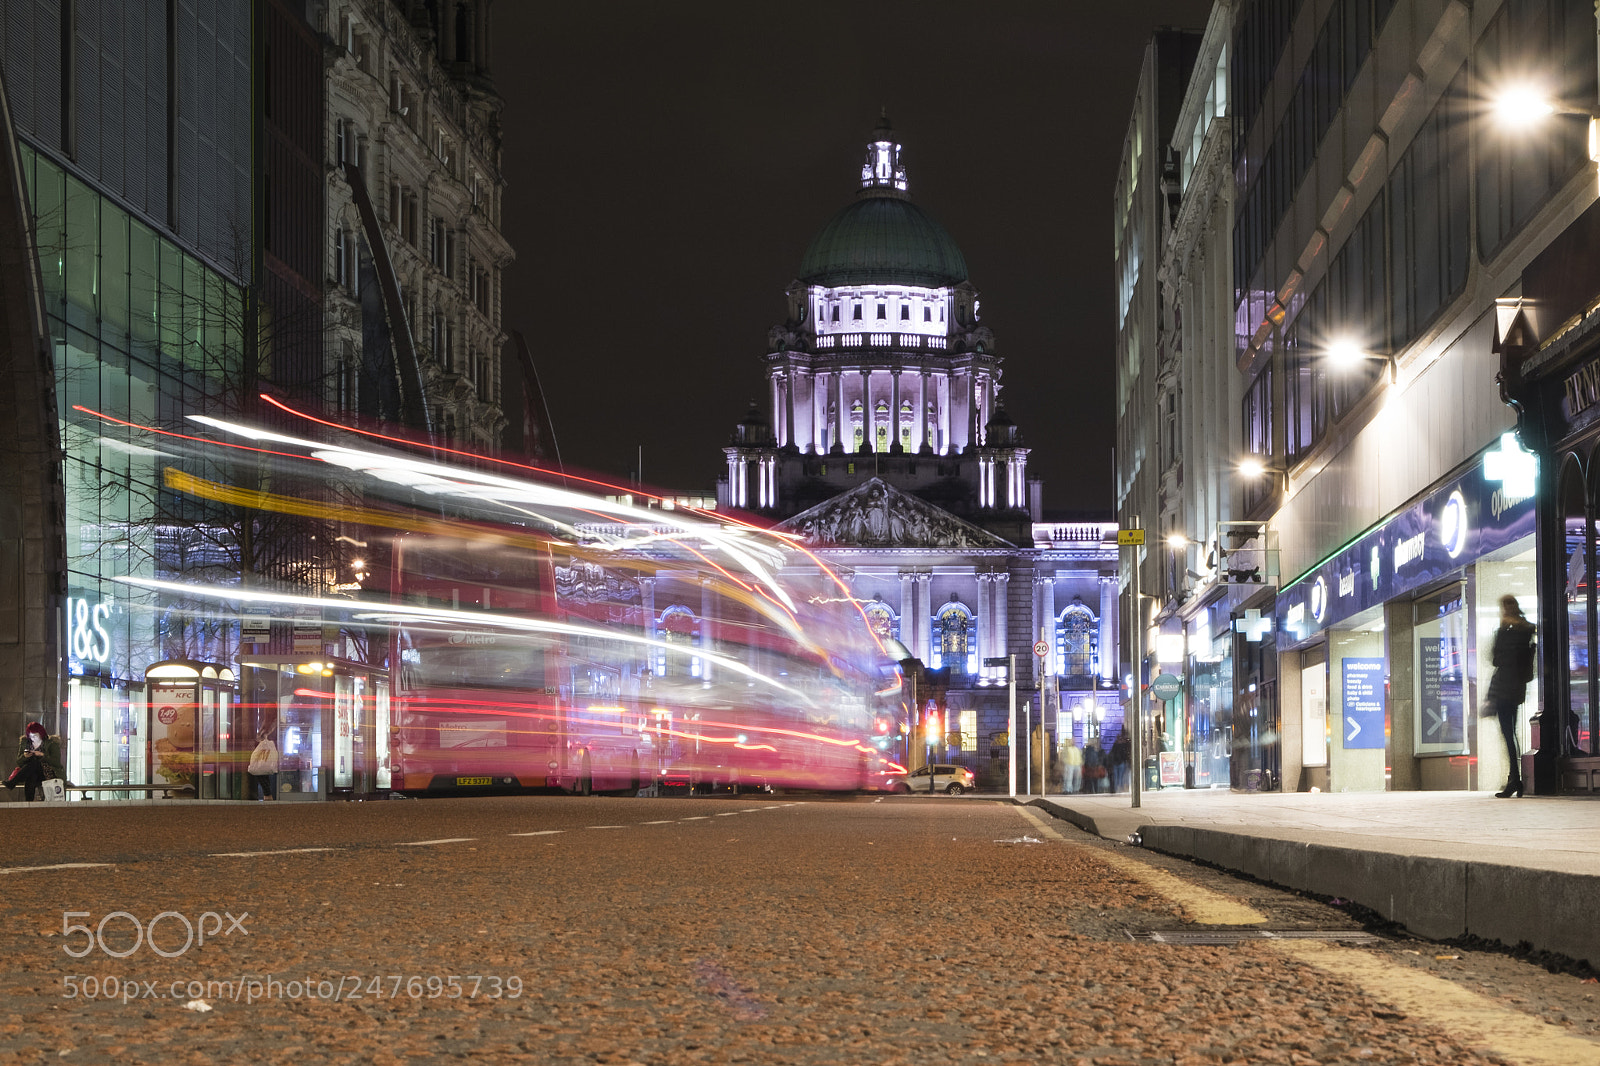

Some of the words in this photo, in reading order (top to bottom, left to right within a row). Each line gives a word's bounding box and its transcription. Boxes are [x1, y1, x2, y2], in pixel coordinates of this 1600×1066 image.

[67, 597, 110, 663] &S
[466, 636, 496, 645] Metro
[1347, 662, 1381, 670] welcome
